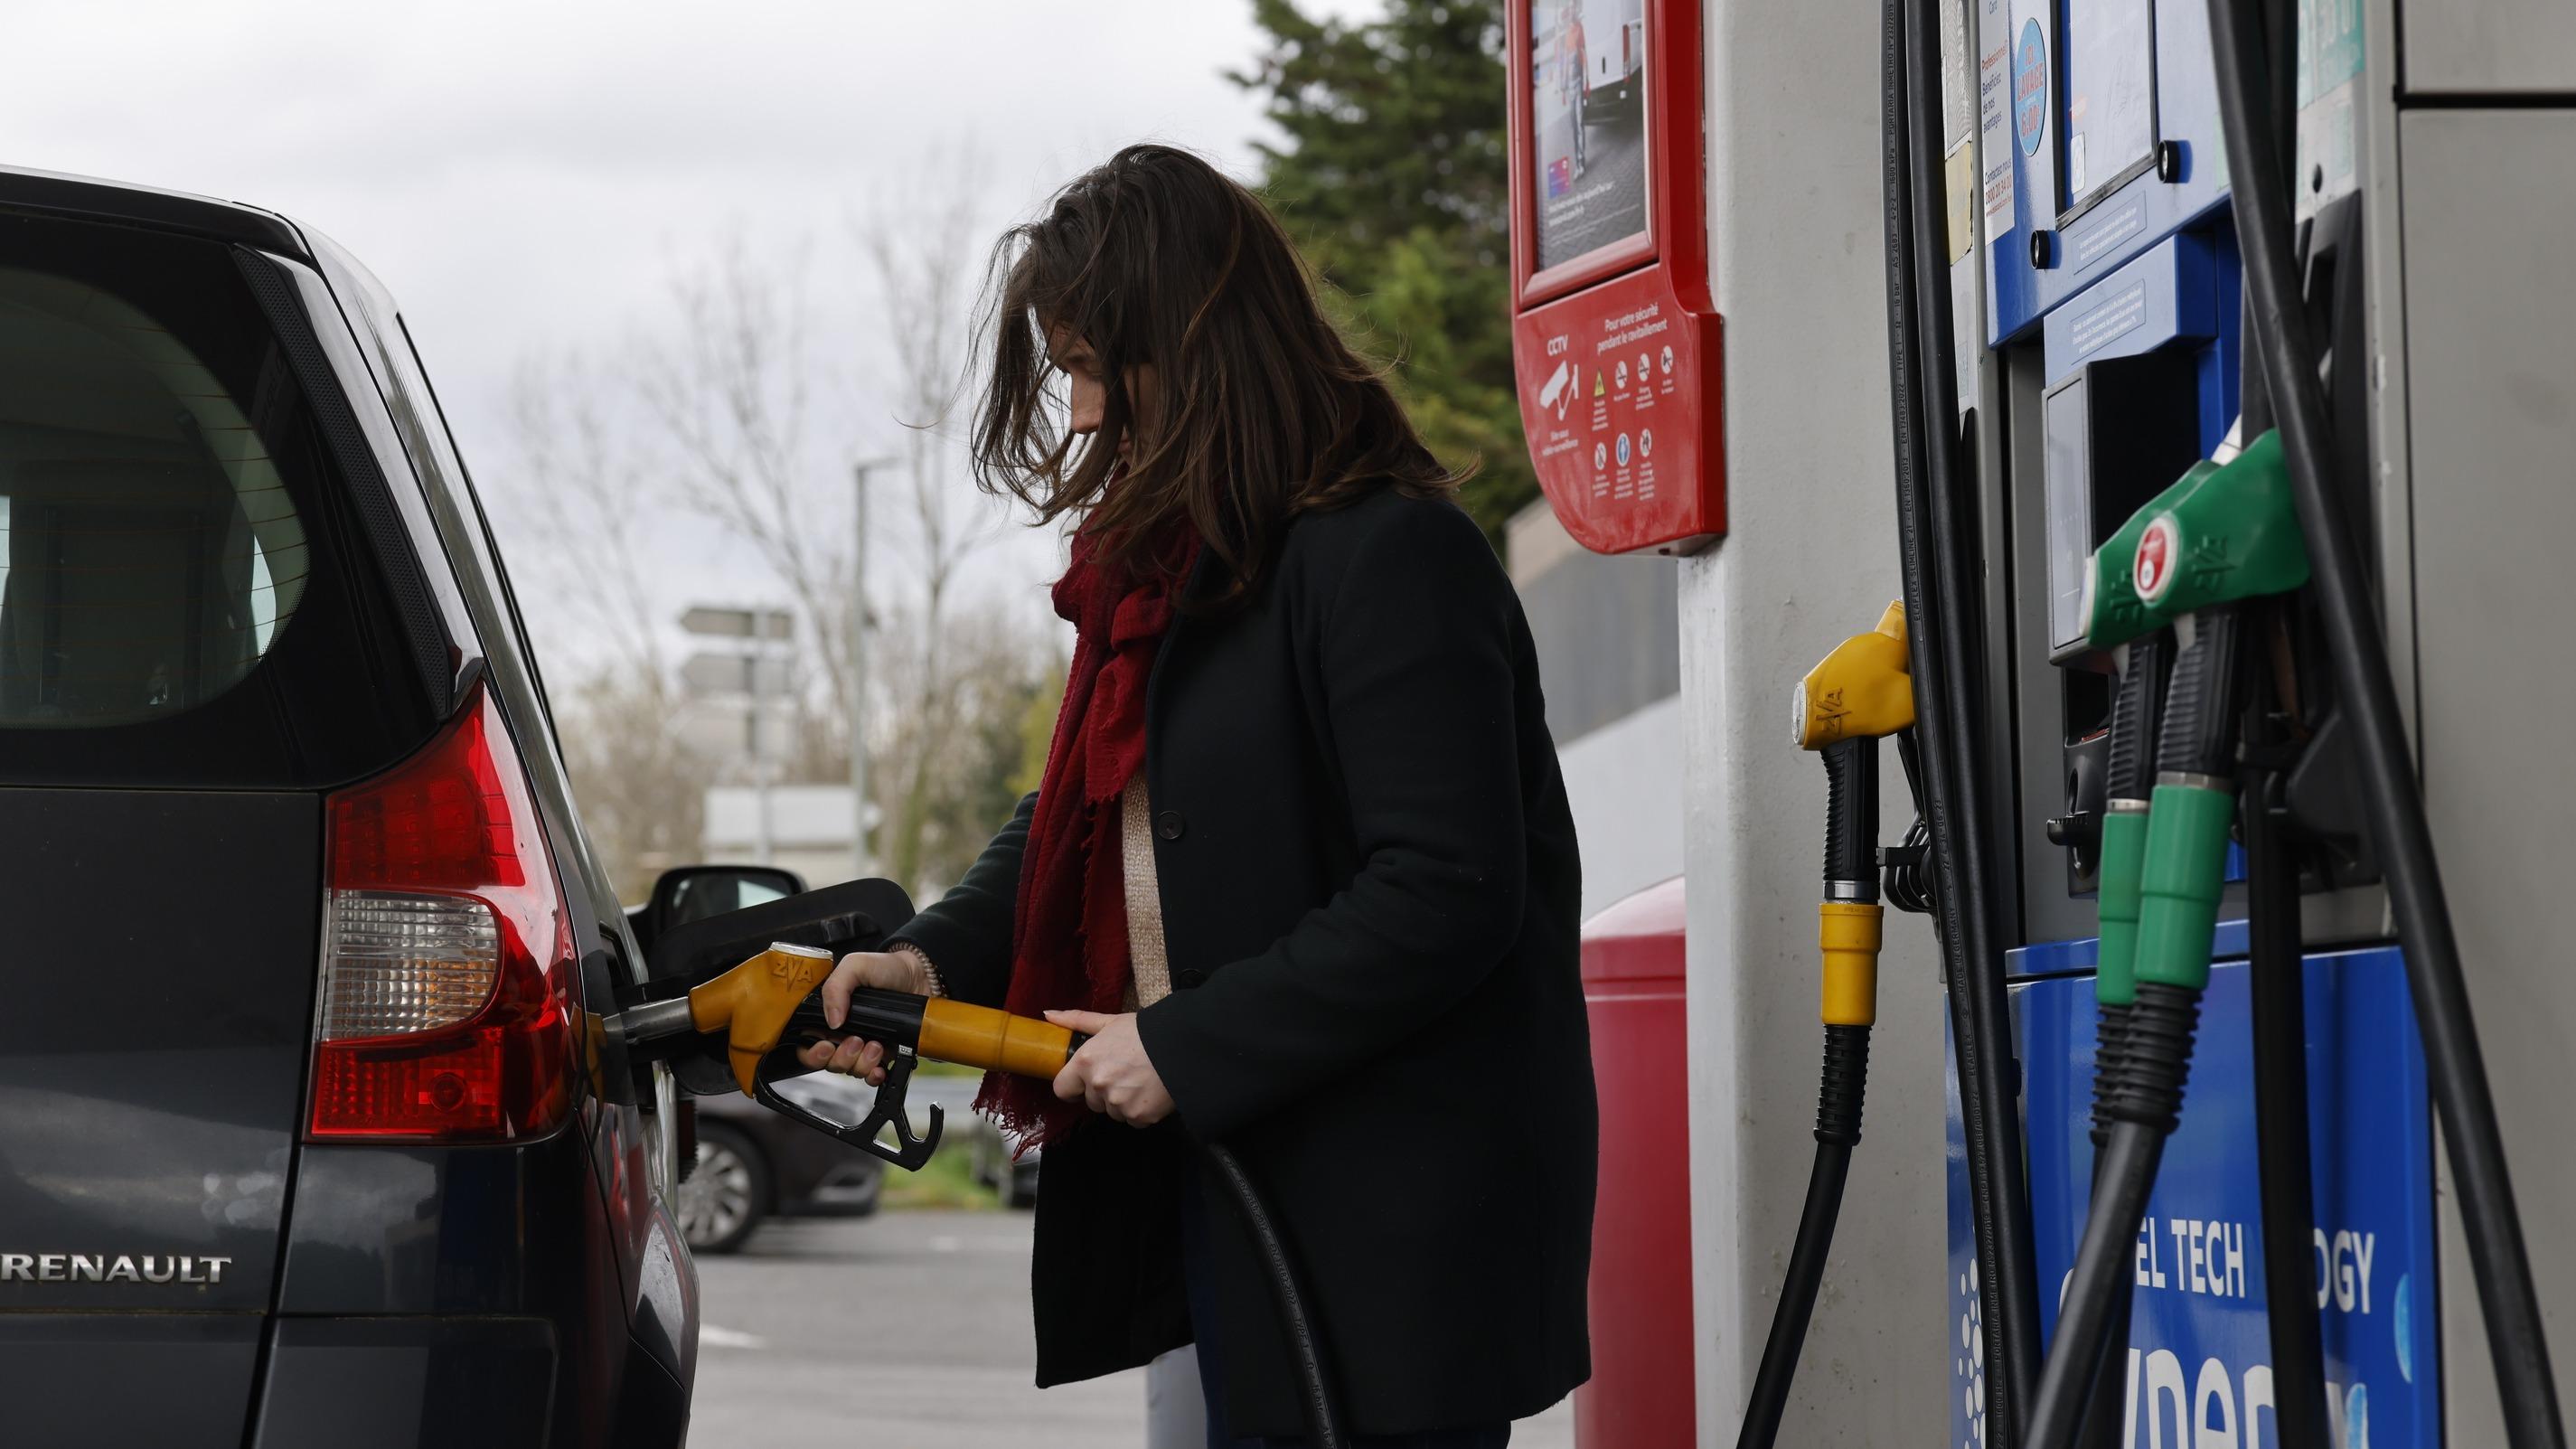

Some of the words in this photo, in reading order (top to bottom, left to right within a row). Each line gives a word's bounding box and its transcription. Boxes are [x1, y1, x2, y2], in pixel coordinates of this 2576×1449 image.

[1886, 52, 1894, 89] INMETRO
[2017, 62, 2043, 101] LAVAGE
[1886, 92, 1895, 135] PORTARIA
[1892, 256, 1898, 268] AS
[1892, 281, 1900, 296] bar
[1605, 318, 1618, 333] Pour
[1620, 314, 1634, 327] votre
[1635, 302, 1659, 322] sécurité
[1547, 334, 1569, 357] CCTV
[1597, 334, 1622, 356] pendant
[1622, 331, 1627, 343] le
[1900, 431, 1907, 444] EN
[1904, 500, 1912, 512] EN
[1905, 537, 1917, 577] SLIMLINE
[1909, 580, 1921, 621] ELAFLEX
[1816, 687, 1852, 736] ZVA
[1948, 907, 1960, 953] GERMANY
[771, 956, 813, 993] ZVA
[1955, 967, 1966, 993] MADE
[1963, 1033, 1976, 1077] ELAFLEX
[0, 1253, 232, 1284] RENAULT
